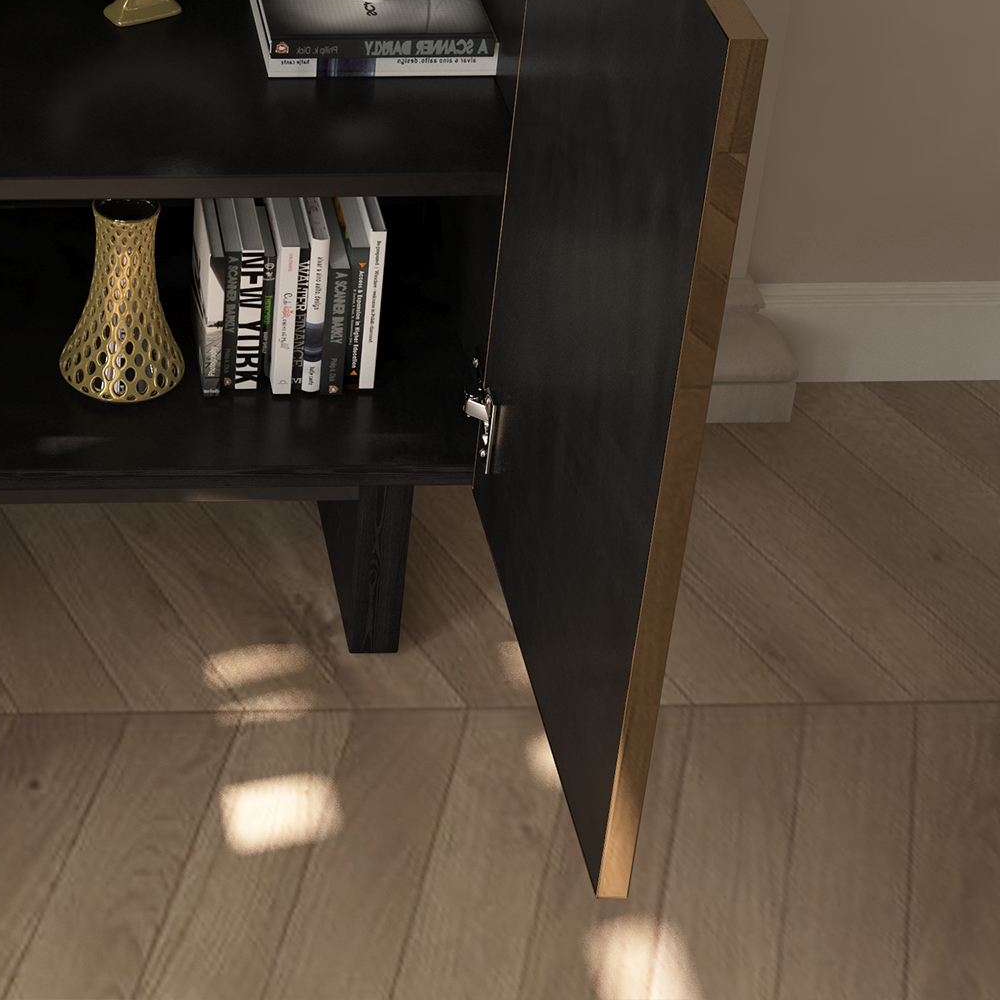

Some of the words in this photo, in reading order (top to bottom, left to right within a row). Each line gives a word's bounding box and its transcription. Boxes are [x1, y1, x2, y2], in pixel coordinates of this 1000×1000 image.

[226, 265, 239, 302] SCANNER
[239, 253, 264, 308] NEW
[296, 259, 310, 311] WALTER
[332, 280, 348, 315] SCANNER
[224, 304, 236, 333] DARKLY
[330, 317, 344, 344] DARKLY
[235, 321, 261, 383] YORK
[292, 312, 306, 368] FINANCE
[351, 344, 359, 369] Education
